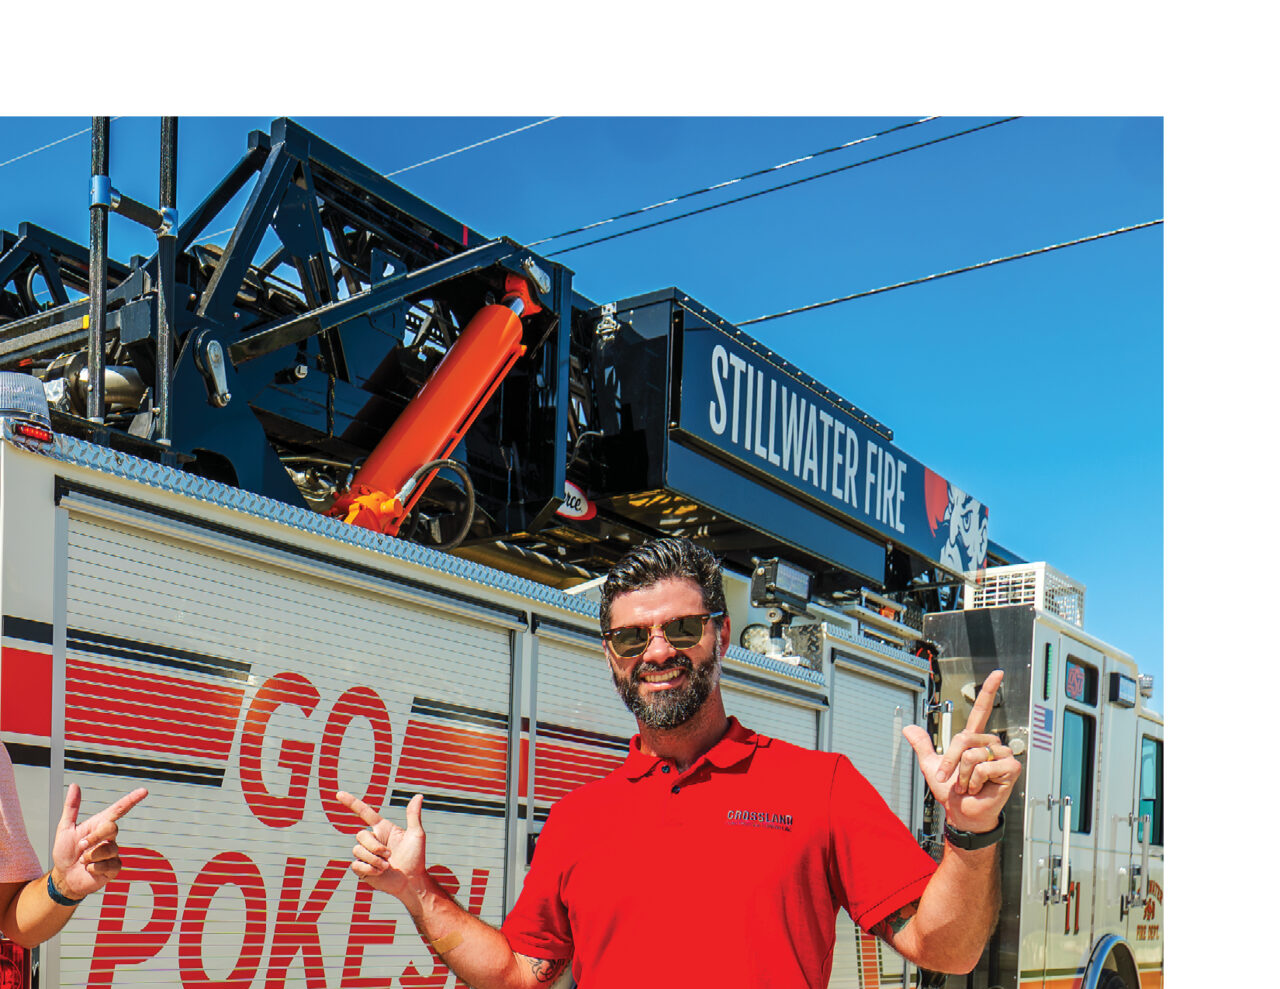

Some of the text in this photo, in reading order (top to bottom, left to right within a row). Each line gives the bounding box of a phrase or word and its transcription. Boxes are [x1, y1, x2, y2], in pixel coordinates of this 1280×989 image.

[709, 344, 907, 534] STILLWATER FIRE
[239, 671, 393, 835] GO
[727, 809, 793, 826] CROSSLAND
